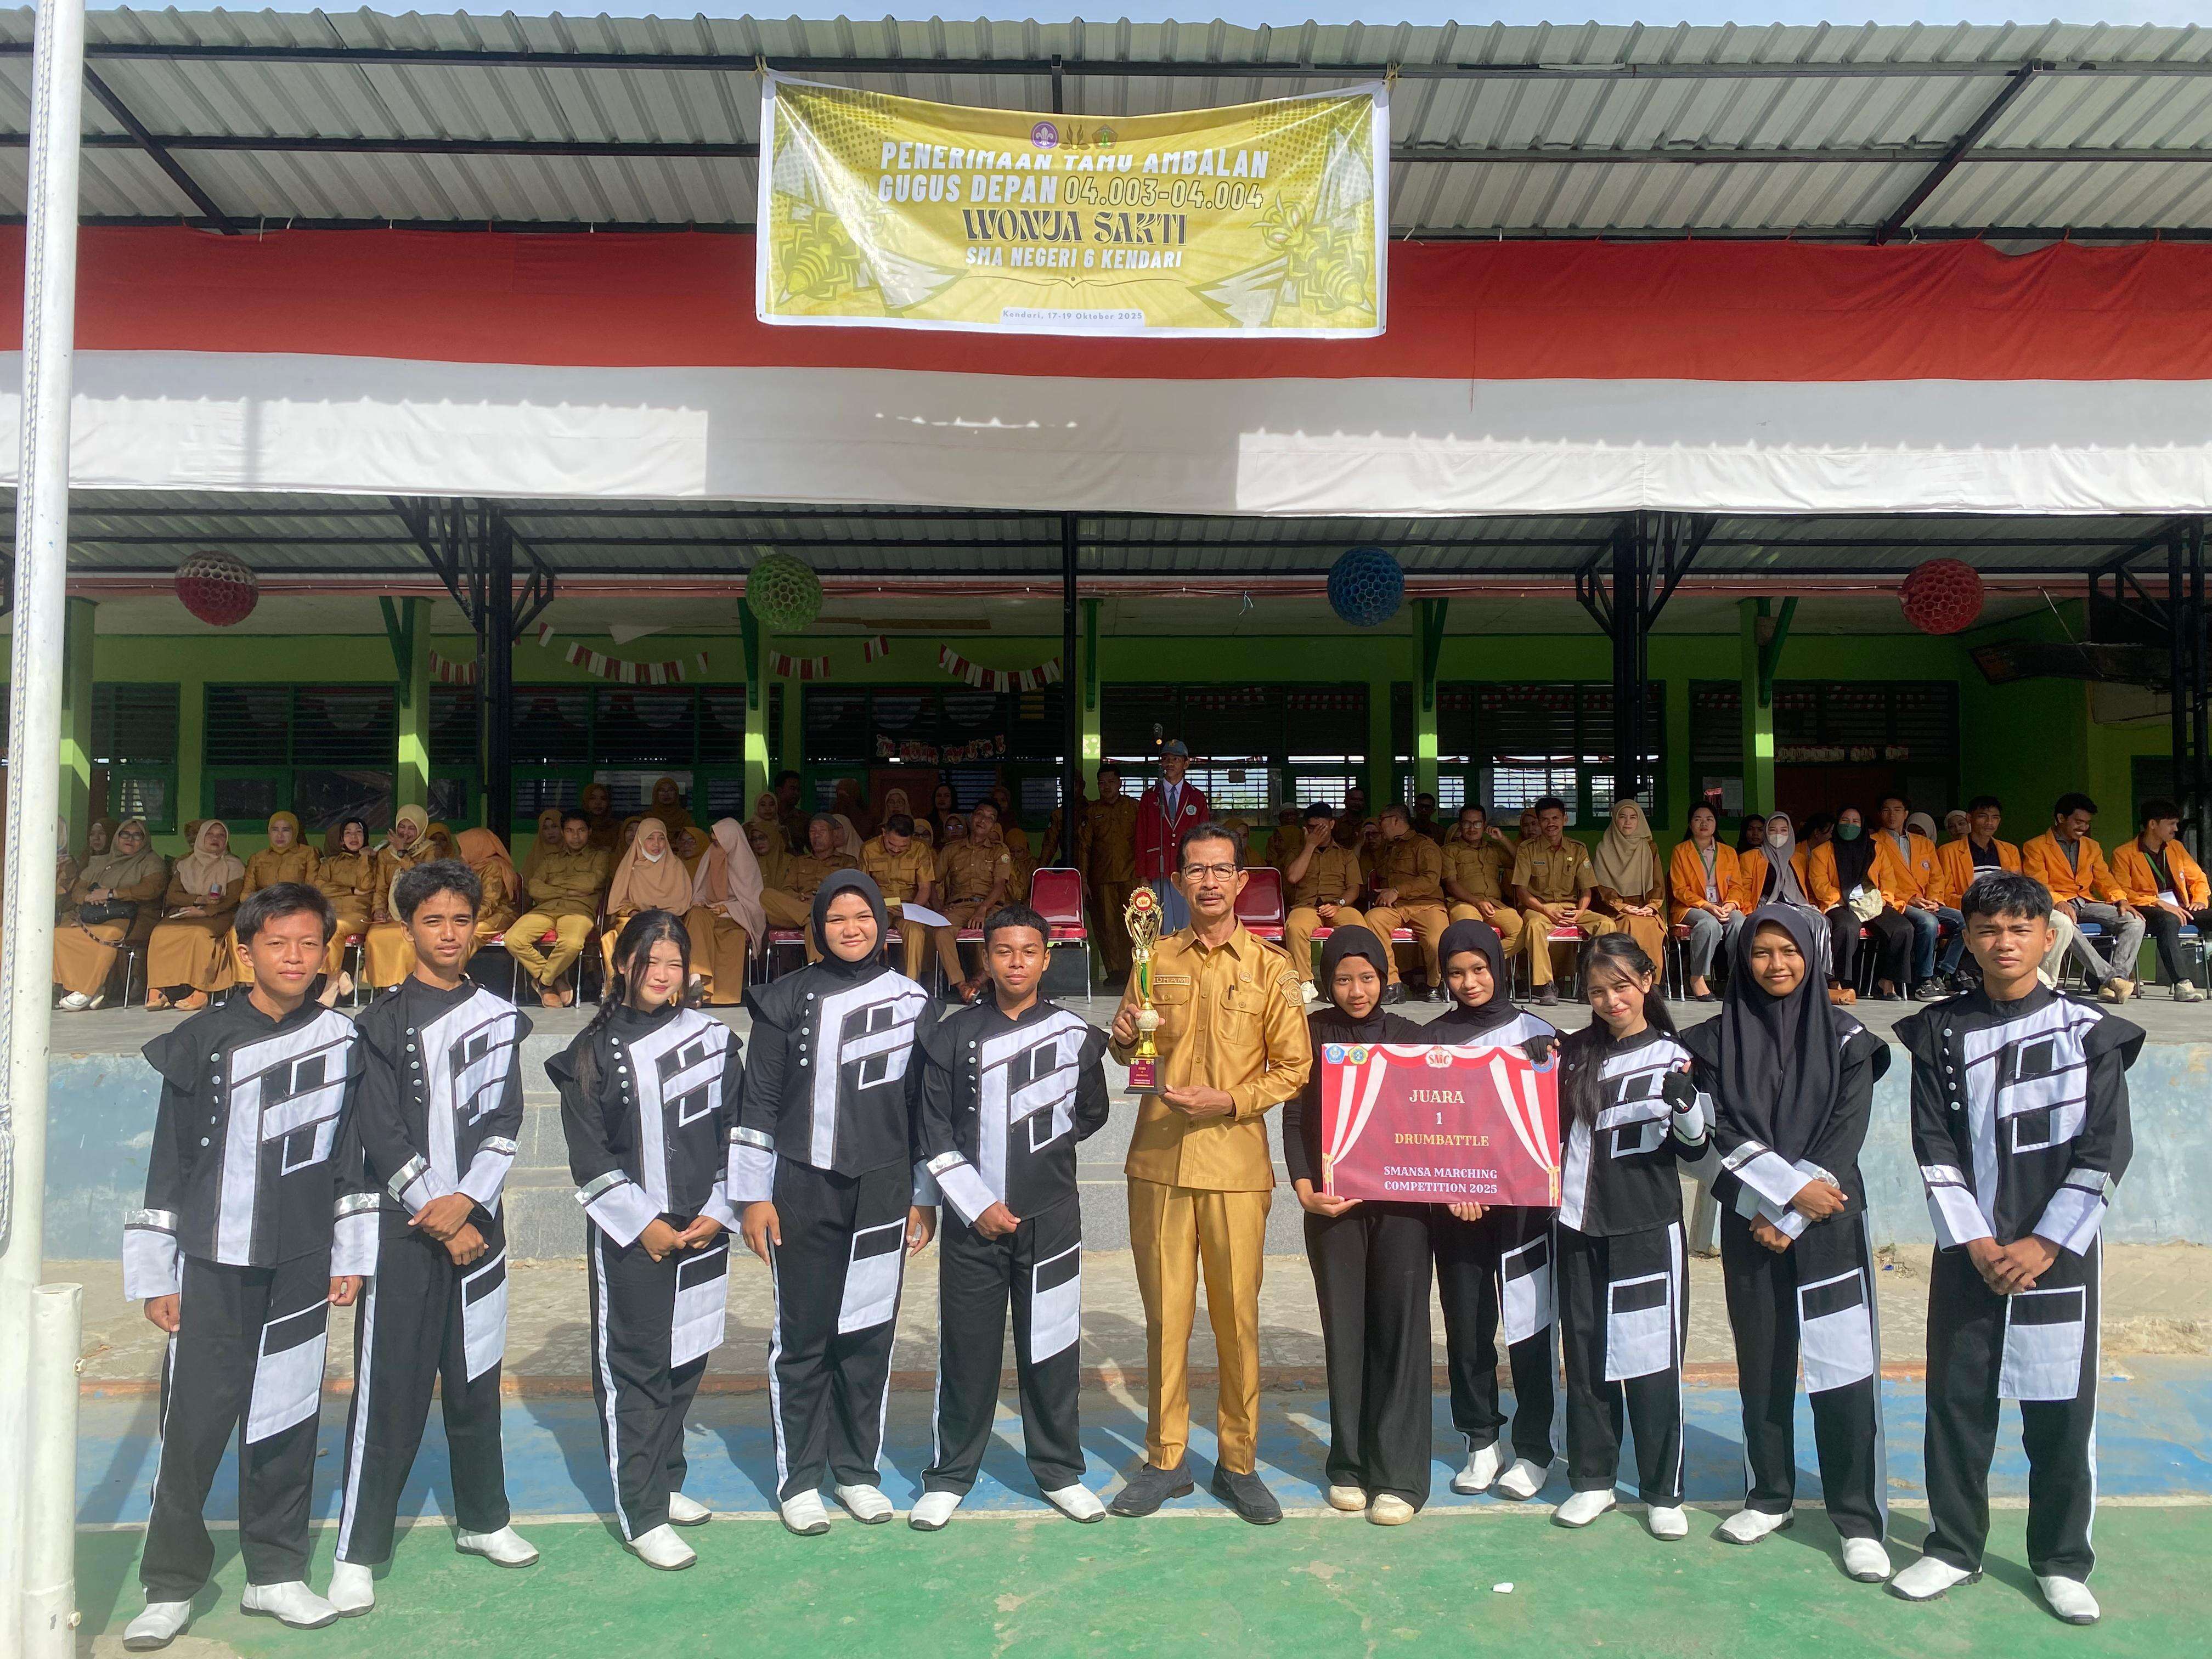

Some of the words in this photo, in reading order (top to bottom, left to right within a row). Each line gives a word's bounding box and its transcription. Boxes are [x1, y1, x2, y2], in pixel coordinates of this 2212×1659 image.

[881, 142, 1052, 170] PENERIMAAN
[1064, 155, 1133, 172] TAMU
[1142, 149, 1269, 178] AMBALAN
[878, 174, 961, 202] GUGUS
[970, 175, 1058, 203] DEPAN
[1064, 176, 1263, 210] 04.003-04.004
[962, 208, 1084, 242] WONUA
[1094, 211, 1188, 245] SAKTI
[966, 247, 1002, 266] SMA
[1011, 247, 1077, 267] NEGERI
[1084, 249, 1094, 268] 6
[1101, 249, 1182, 269] KENDARI
[1003, 311, 1043, 319] Kendari,
[1409, 1090, 1465, 1103] JUARA
[1436, 1111, 1442, 1125] 1
[1395, 1133, 1489, 1147] DRUMBATTLE
[1384, 1166, 1431, 1177] SMANSA
[1434, 1167, 1497, 1179] MARCHING
[1384, 1181, 1466, 1193] COMPETITION
[1470, 1184, 1498, 1194] 2025
